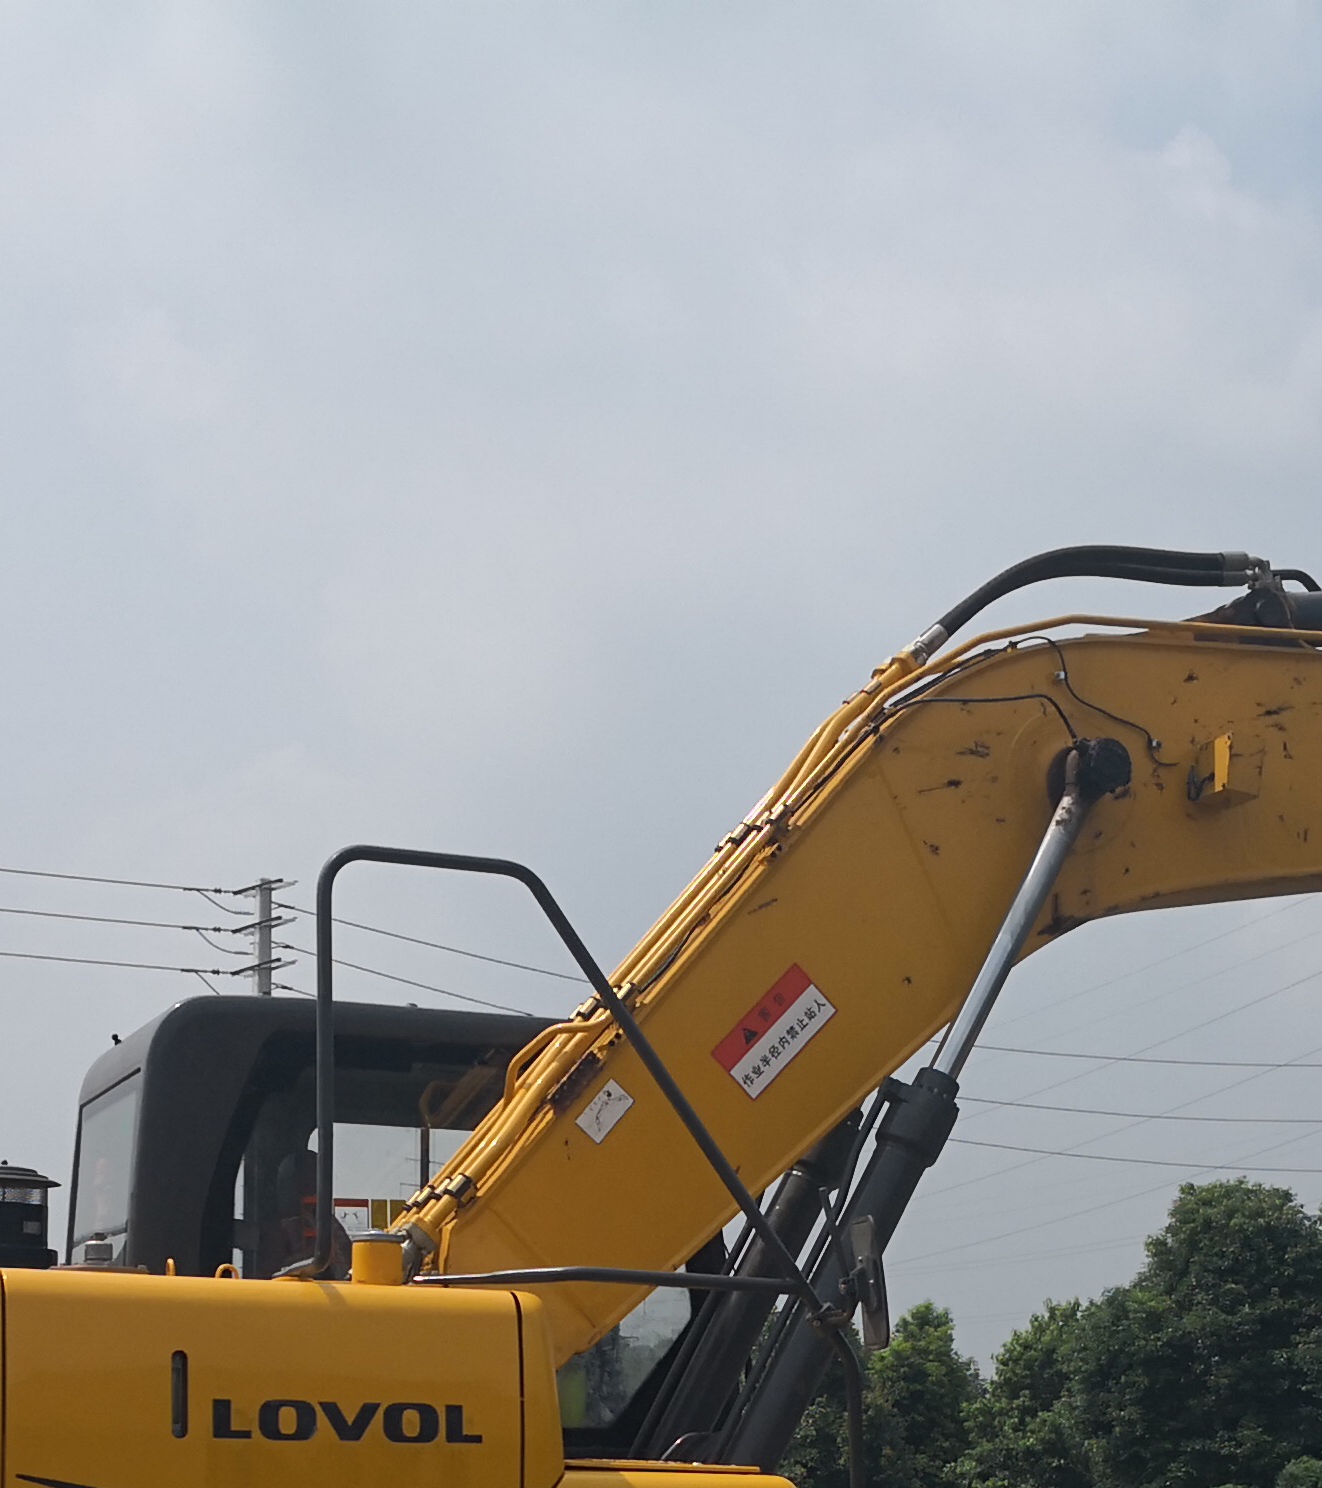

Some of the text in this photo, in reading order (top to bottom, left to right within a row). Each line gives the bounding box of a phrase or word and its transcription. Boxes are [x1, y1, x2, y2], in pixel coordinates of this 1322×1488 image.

[741, 999, 826, 1088] 作业半径内禁止站人
[212, 1398, 483, 1444] LOVOL
